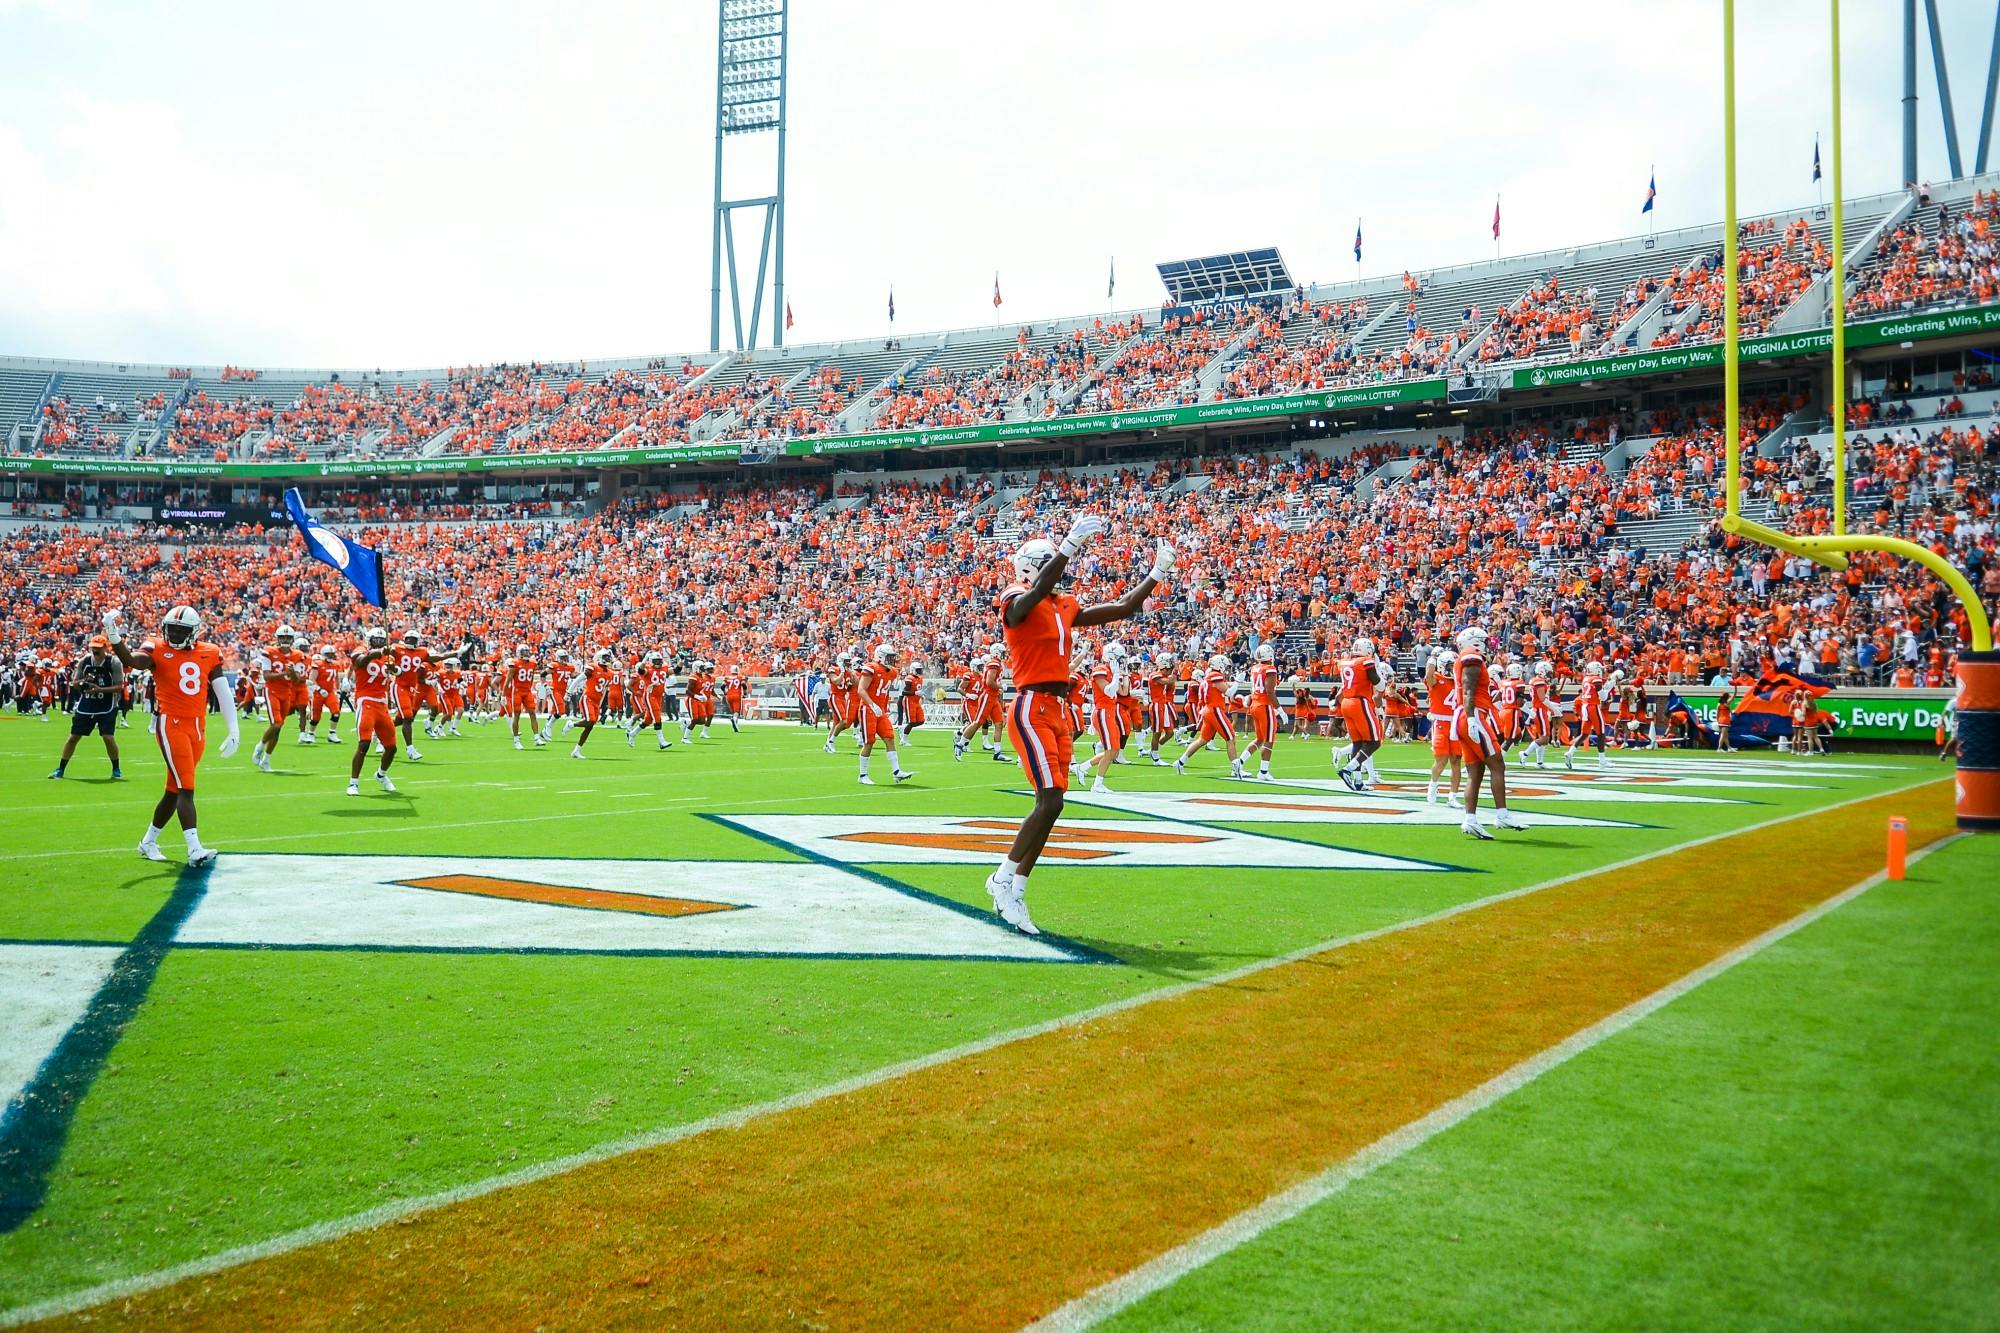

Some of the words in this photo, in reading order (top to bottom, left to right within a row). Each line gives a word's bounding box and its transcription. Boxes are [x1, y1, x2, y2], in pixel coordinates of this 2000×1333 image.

[1881, 319, 1946, 337] Celebrating
[1948, 313, 1982, 328] Wins,
[1741, 340, 1789, 355] VIRGINIA
[1791, 334, 1833, 351] LOTTER
[1548, 367, 1589, 380] VIRGINIA
[1611, 361, 1636, 374] Every
[1639, 358, 1659, 371] Day,
[1661, 354, 1687, 368] Every
[1689, 351, 1714, 363] Way.
[1198, 405, 1233, 418] Celebrating
[1234, 404, 1251, 414] Wins,
[1252, 402, 1270, 413] Every
[1271, 400, 1285, 411] Day,
[1286, 399, 1304, 409] Every
[1304, 397, 1320, 407] Way.
[1336, 393, 1367, 404] VIRGINIA
[1368, 389, 1401, 401] LOTTERY
[998, 427, 1029, 435] Celebrating
[1030, 426, 1046, 434] Wins,
[1047, 424, 1062, 433] Every
[1076, 421, 1092, 430] Every
[1121, 417, 1148, 425] VIRGINIA
[1149, 413, 1177, 423] LOTTERY
[823, 441, 849, 449] VIRGINIA
[930, 434, 953, 442] VIRGINIA
[954, 431, 980, 439] LOTTERY
[607, 454, 629, 462] LOTTERY
[645, 452, 672, 460] Celebrating
[4, 461, 32, 469] LOTTERY
[52, 463, 84, 472] Celebrating
[199, 467, 223, 475] LOTTERY
[170, 510, 198, 518] VIRGINIA
[198, 510, 226, 518] LOTTERY
[1055, 612, 1065, 656] 1
[401, 655, 421, 672] 89
[179, 661, 201, 695] 8
[651, 670, 667, 684] 63
[1852, 708, 1908, 731] Every
